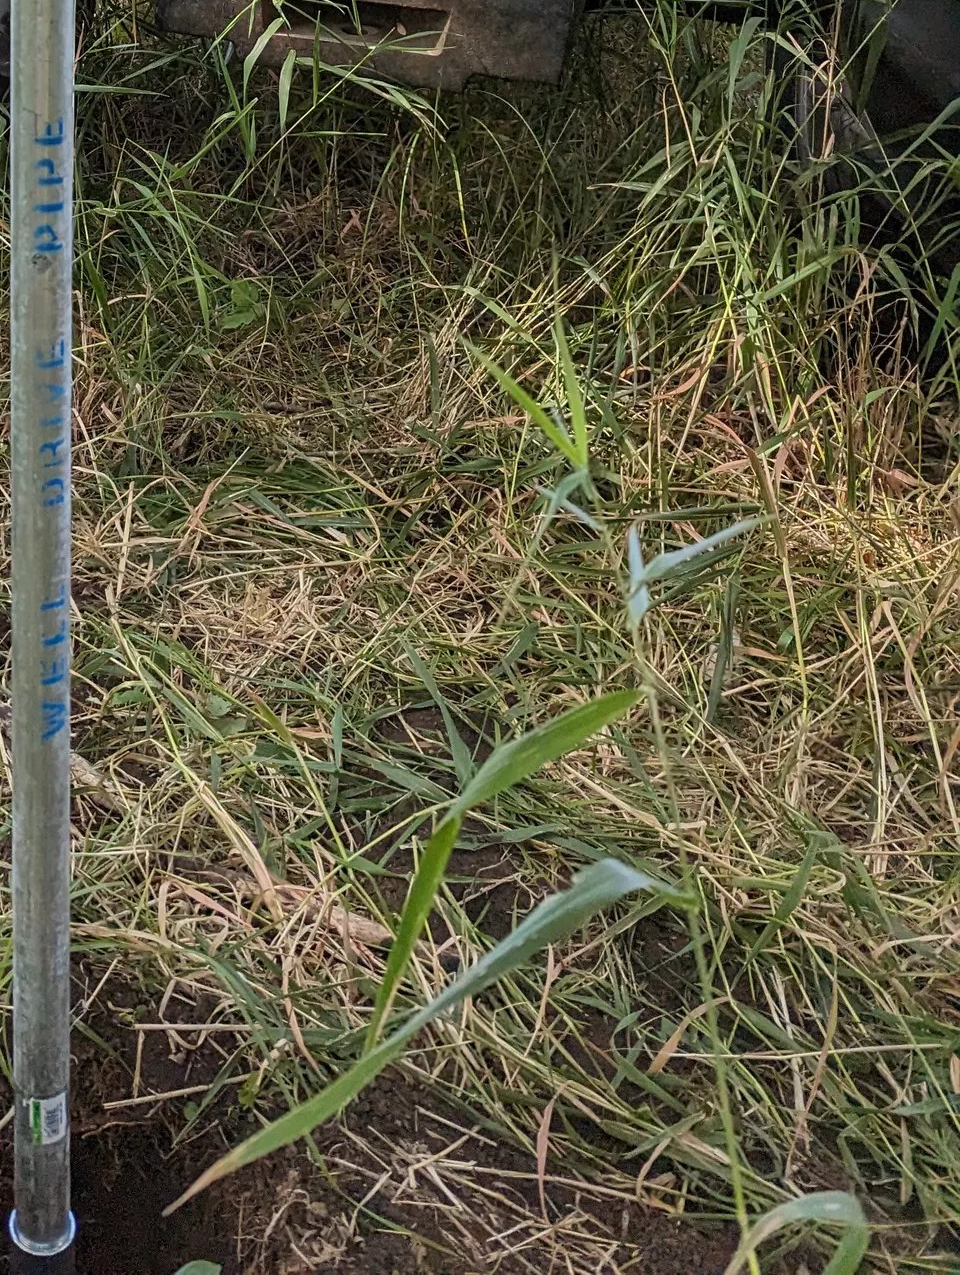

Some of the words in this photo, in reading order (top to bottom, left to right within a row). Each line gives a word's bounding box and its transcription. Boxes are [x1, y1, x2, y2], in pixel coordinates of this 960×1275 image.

[34, 115, 64, 253] PIPE
[36, 339, 65, 507] DRIVE
[39, 585, 66, 741] WELL
